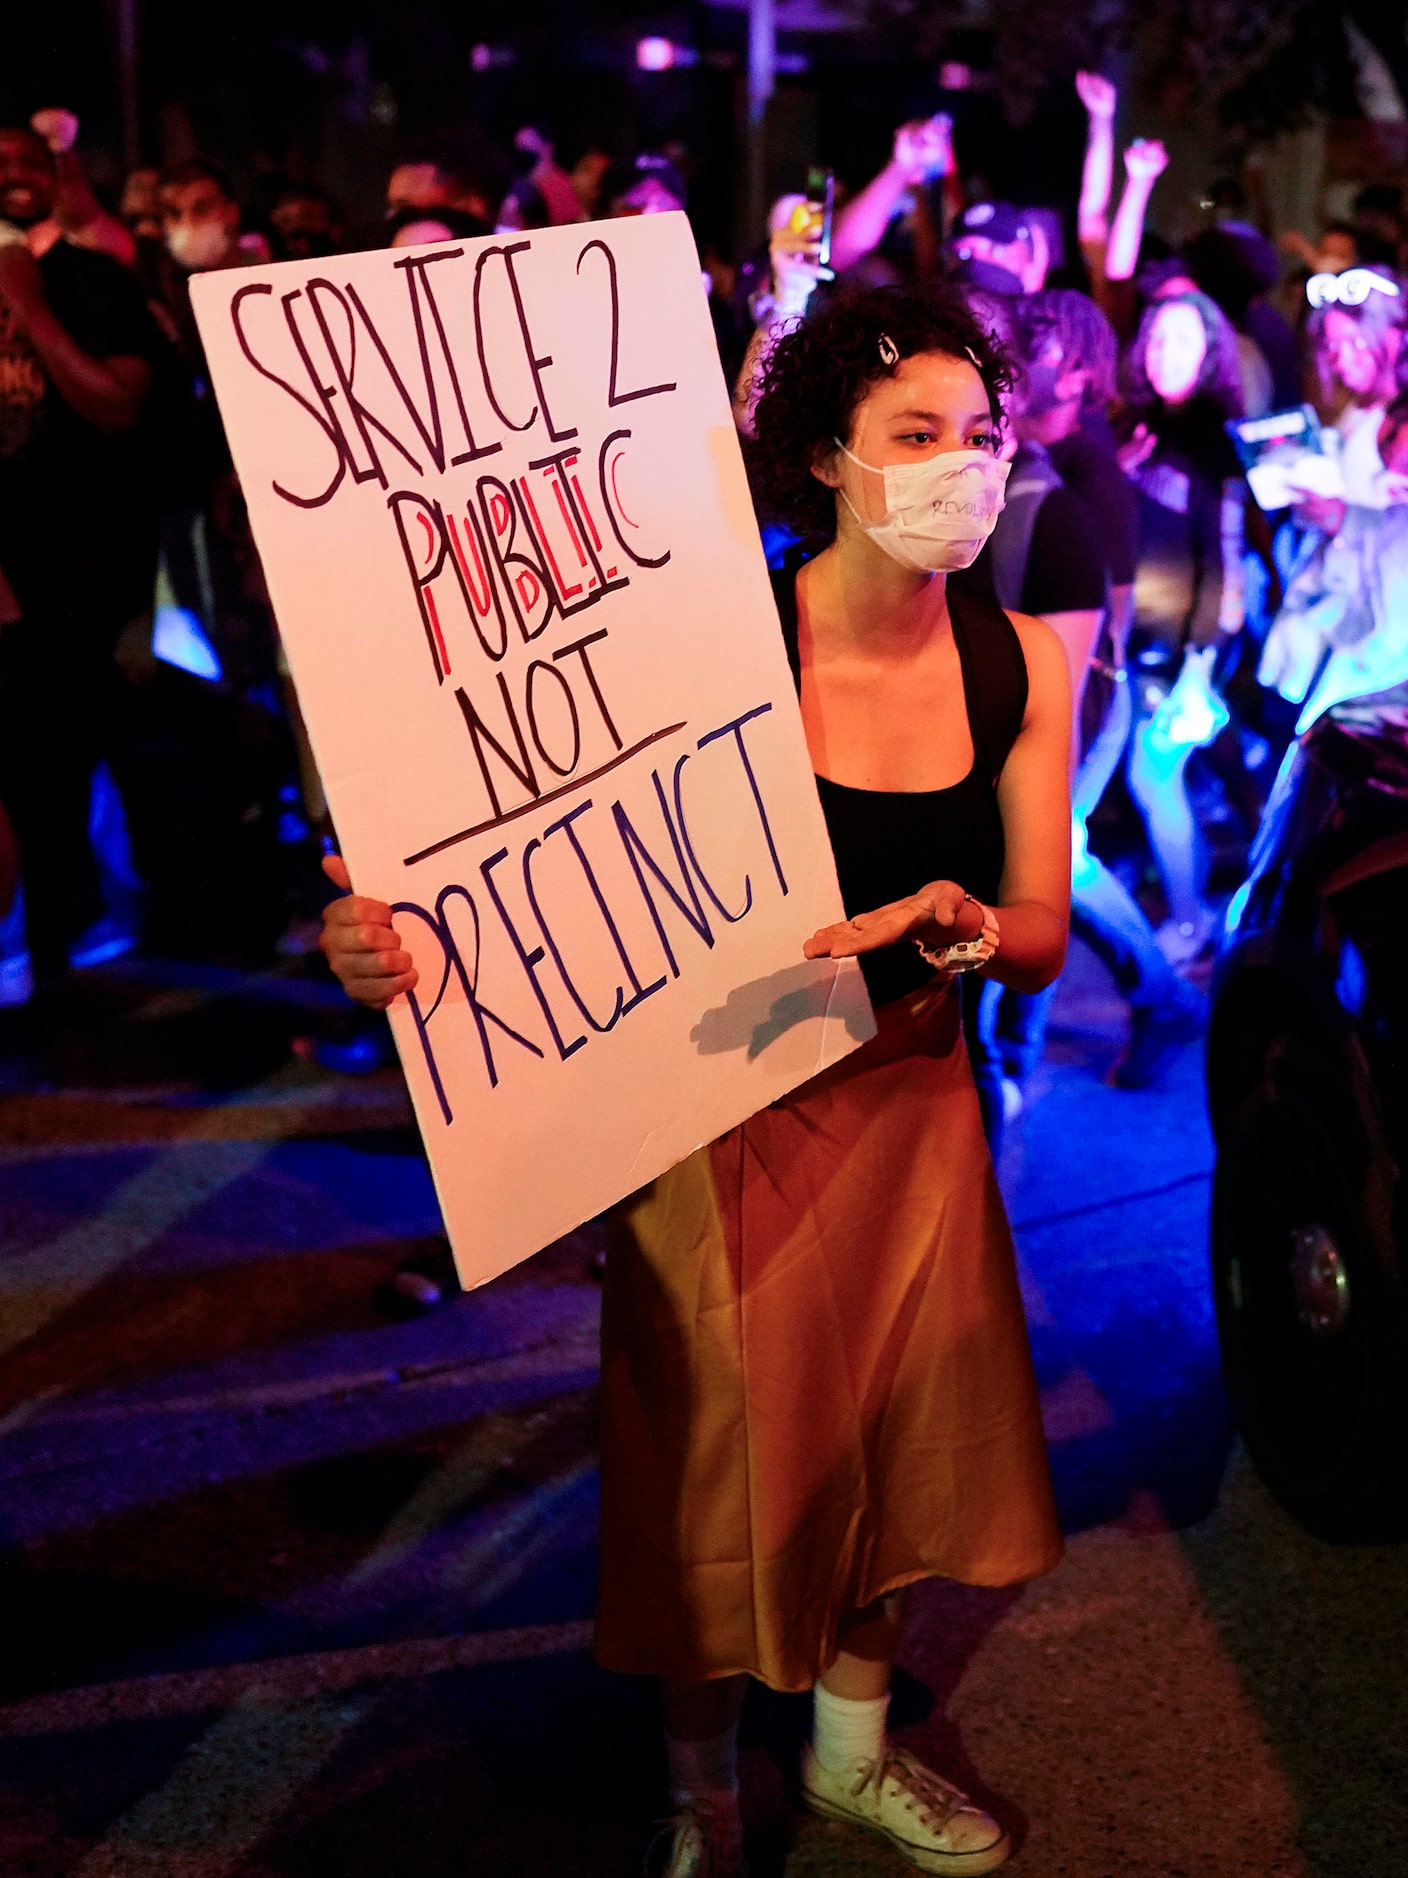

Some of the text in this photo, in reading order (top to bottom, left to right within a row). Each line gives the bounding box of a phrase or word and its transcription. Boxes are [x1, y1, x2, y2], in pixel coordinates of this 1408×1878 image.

[232, 240, 677, 508] SERVICE 2
[388, 430, 671, 685] PUBLIC
[454, 629, 622, 818] NOT
[389, 703, 791, 1126] PRECINCT
